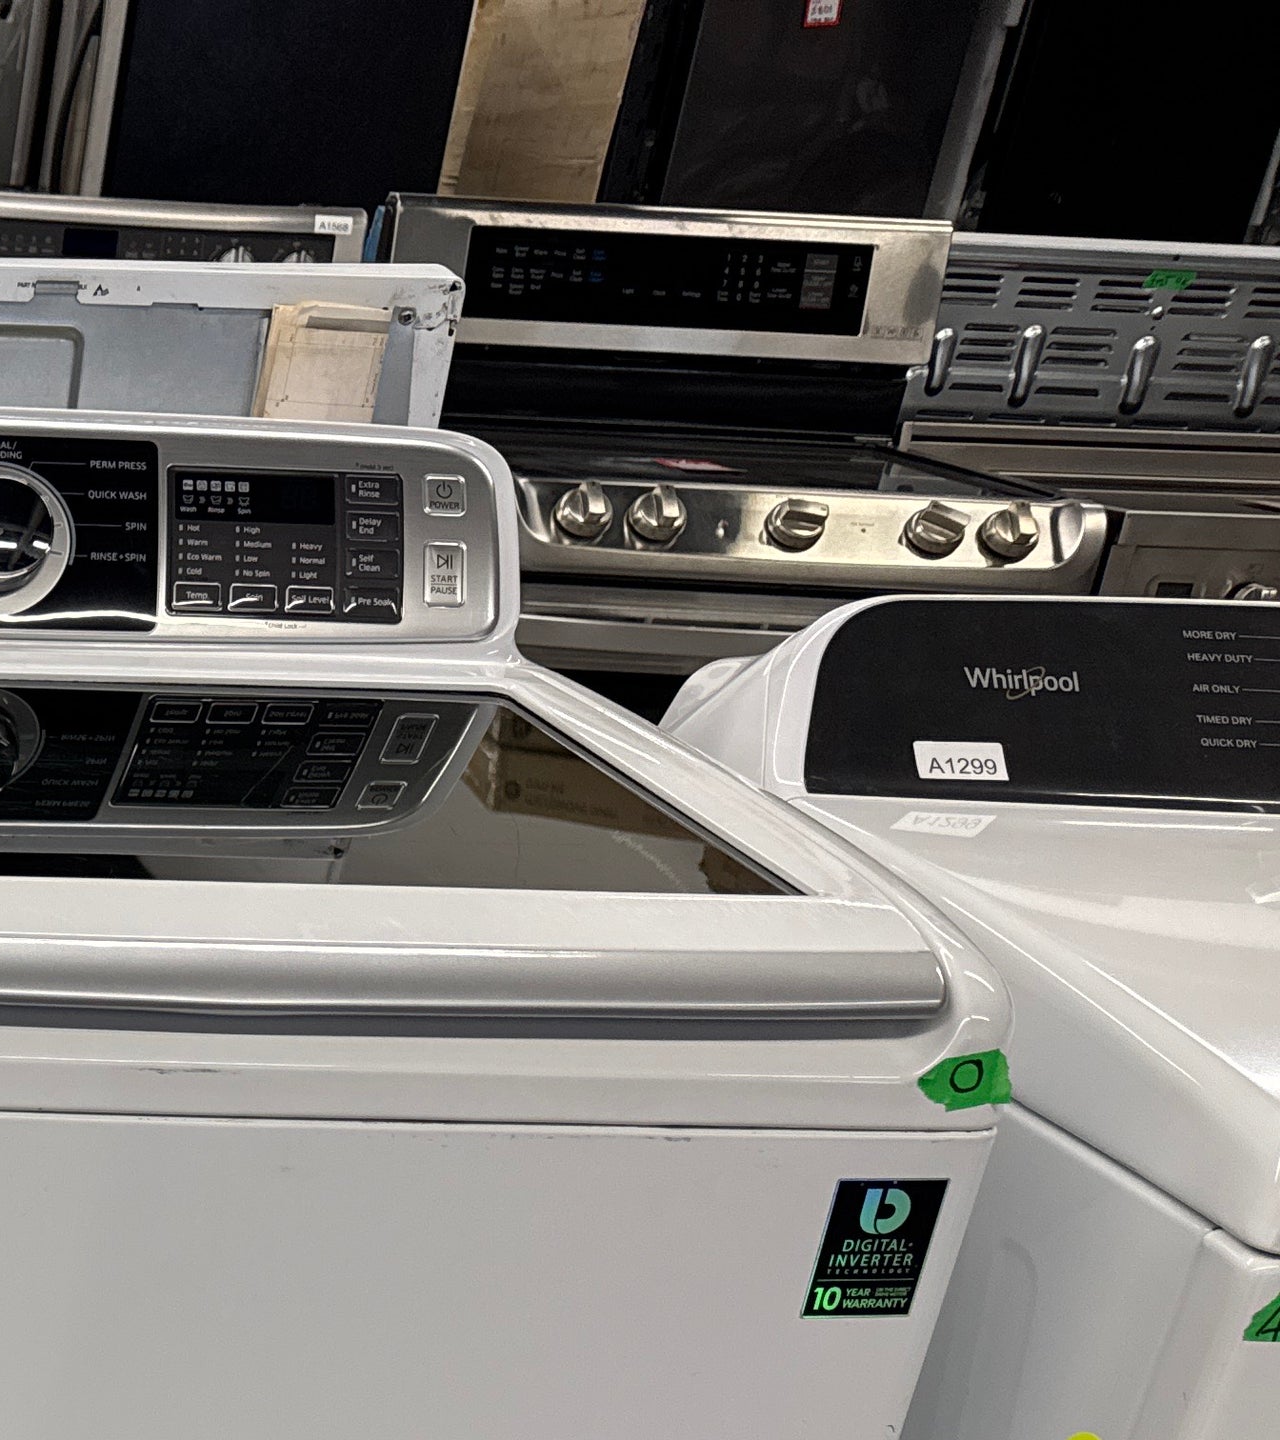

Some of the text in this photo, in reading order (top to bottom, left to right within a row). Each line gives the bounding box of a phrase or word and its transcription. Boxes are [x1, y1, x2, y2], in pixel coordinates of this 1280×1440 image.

[90, 460, 147, 471] PERM PRESS
[358, 481, 380, 489] Extra
[87, 490, 147, 501] QUICK WASH
[358, 489, 380, 498] Rinse
[429, 501, 460, 510] POWER
[237, 507, 251, 516] Spin
[125, 521, 147, 531] SPIN
[358, 517, 382, 527] Delay
[187, 524, 200, 532] Hot
[243, 525, 261, 534] High
[358, 526, 374, 535] End
[187, 538, 209, 546] Warm
[243, 540, 272, 549] Medium
[299, 542, 323, 551] Heavy
[186, 553, 200, 561] Eco
[243, 555, 259, 563] Low
[299, 557, 325, 565] Normal
[358, 554, 374, 563] Self
[186, 567, 202, 576] Cold
[358, 563, 381, 572] Clean
[243, 569, 271, 578] No Spin
[299, 571, 318, 580] Light
[430, 574, 458, 584] START
[430, 586, 458, 595] PAUSE
[308, 595, 329, 604] Level
[358, 597, 372, 606] Pre
[1182, 630, 1237, 641] MORE DRY
[1187, 653, 1253, 664] HEAVY DUTY
[964, 666, 1080, 696] Whirlpool
[1192, 684, 1240, 695] AIR ONLY
[1196, 715, 1253, 726] TIMED DRY
[1200, 738, 1258, 749] QUICK DRY
[928, 757, 998, 776] A1299
[842, 1238, 908, 1252] DIGITAL
[828, 1253, 913, 1267] INVERTER
[846, 1287, 871, 1297] YEAR
[813, 1286, 842, 1311] 10
[842, 1298, 908, 1309] WARRANTY
